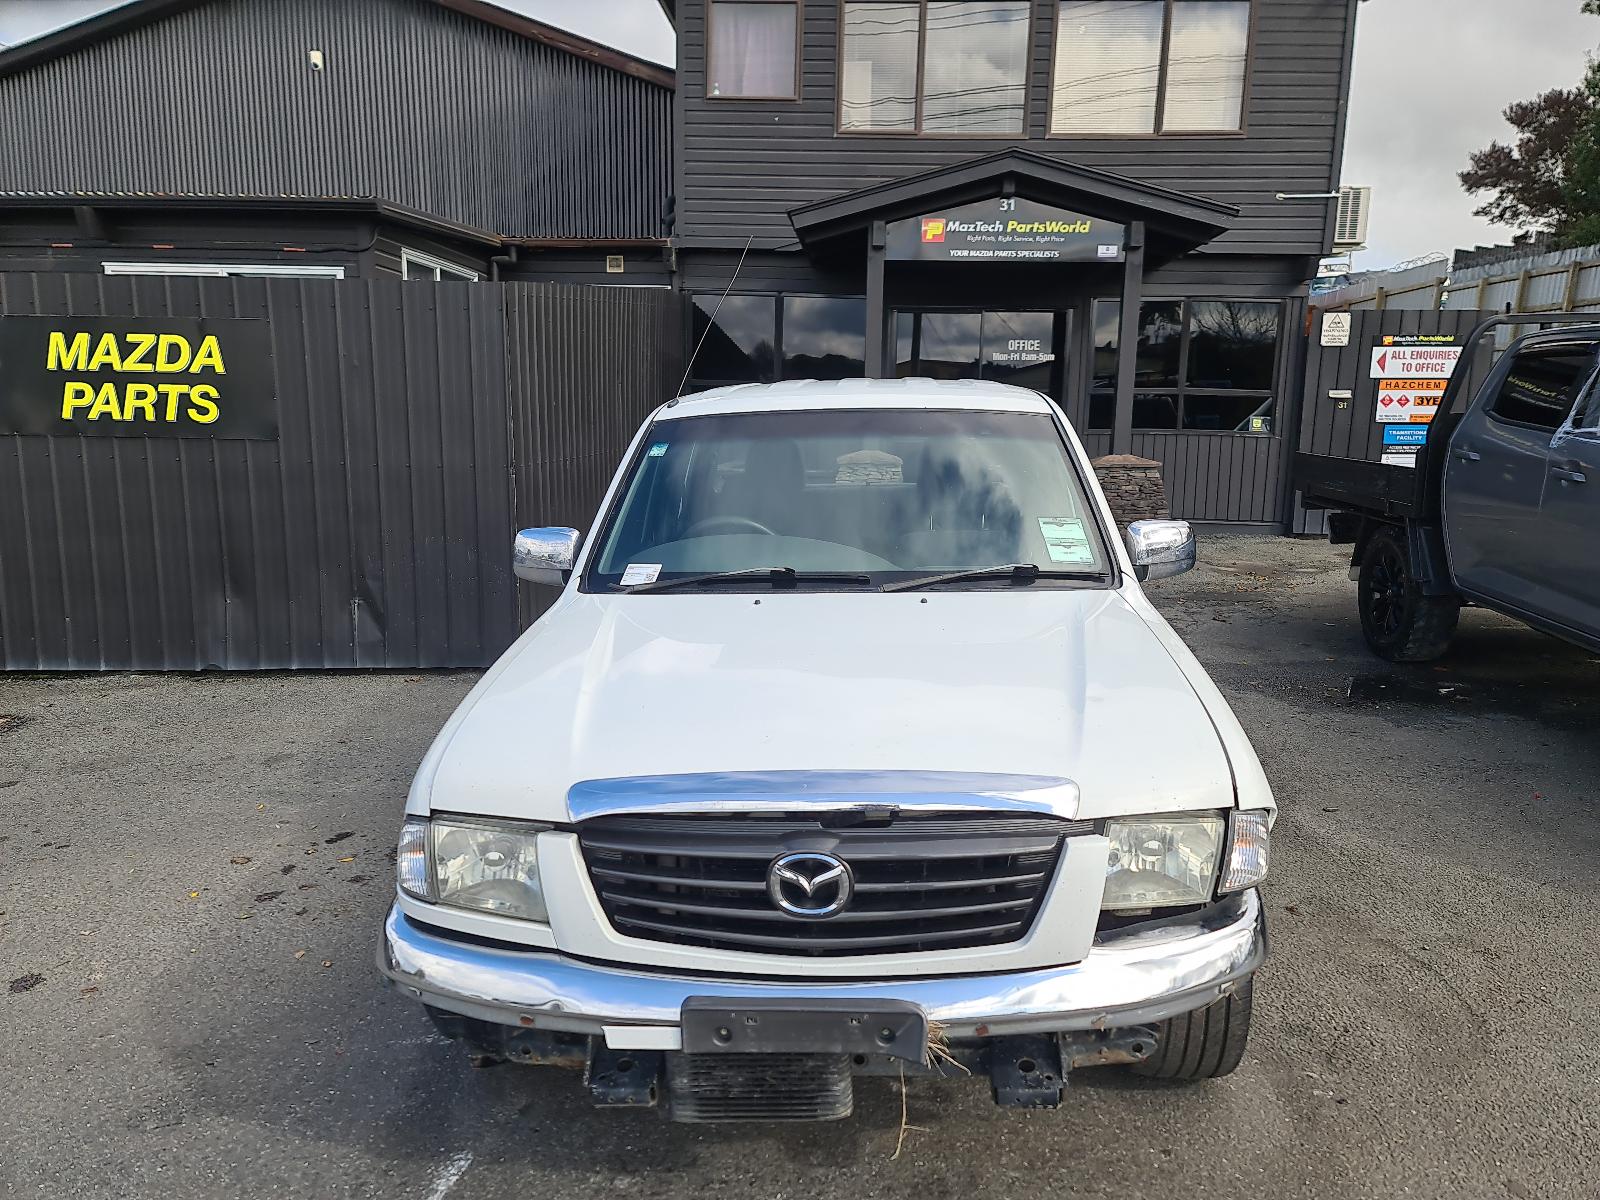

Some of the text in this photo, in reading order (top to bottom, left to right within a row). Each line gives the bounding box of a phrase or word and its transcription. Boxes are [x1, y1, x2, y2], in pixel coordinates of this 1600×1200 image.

[1000, 199, 1015, 210] 31
[946, 220, 1091, 233] MazTech PartsWorld
[949, 249, 970, 257] YOUR
[1017, 250, 1060, 258] SPECIALISTS
[1008, 340, 1041, 351] OFFICE
[47, 331, 227, 375] MAZDA
[992, 352, 1055, 361] Mon-Fri 8am-5pm
[1391, 350, 1459, 360] ALL ENQUIRIES
[1401, 362, 1446, 373] TO OFFICE
[1385, 381, 1441, 389] HAZCHEM
[61, 381, 221, 424] PARTS
